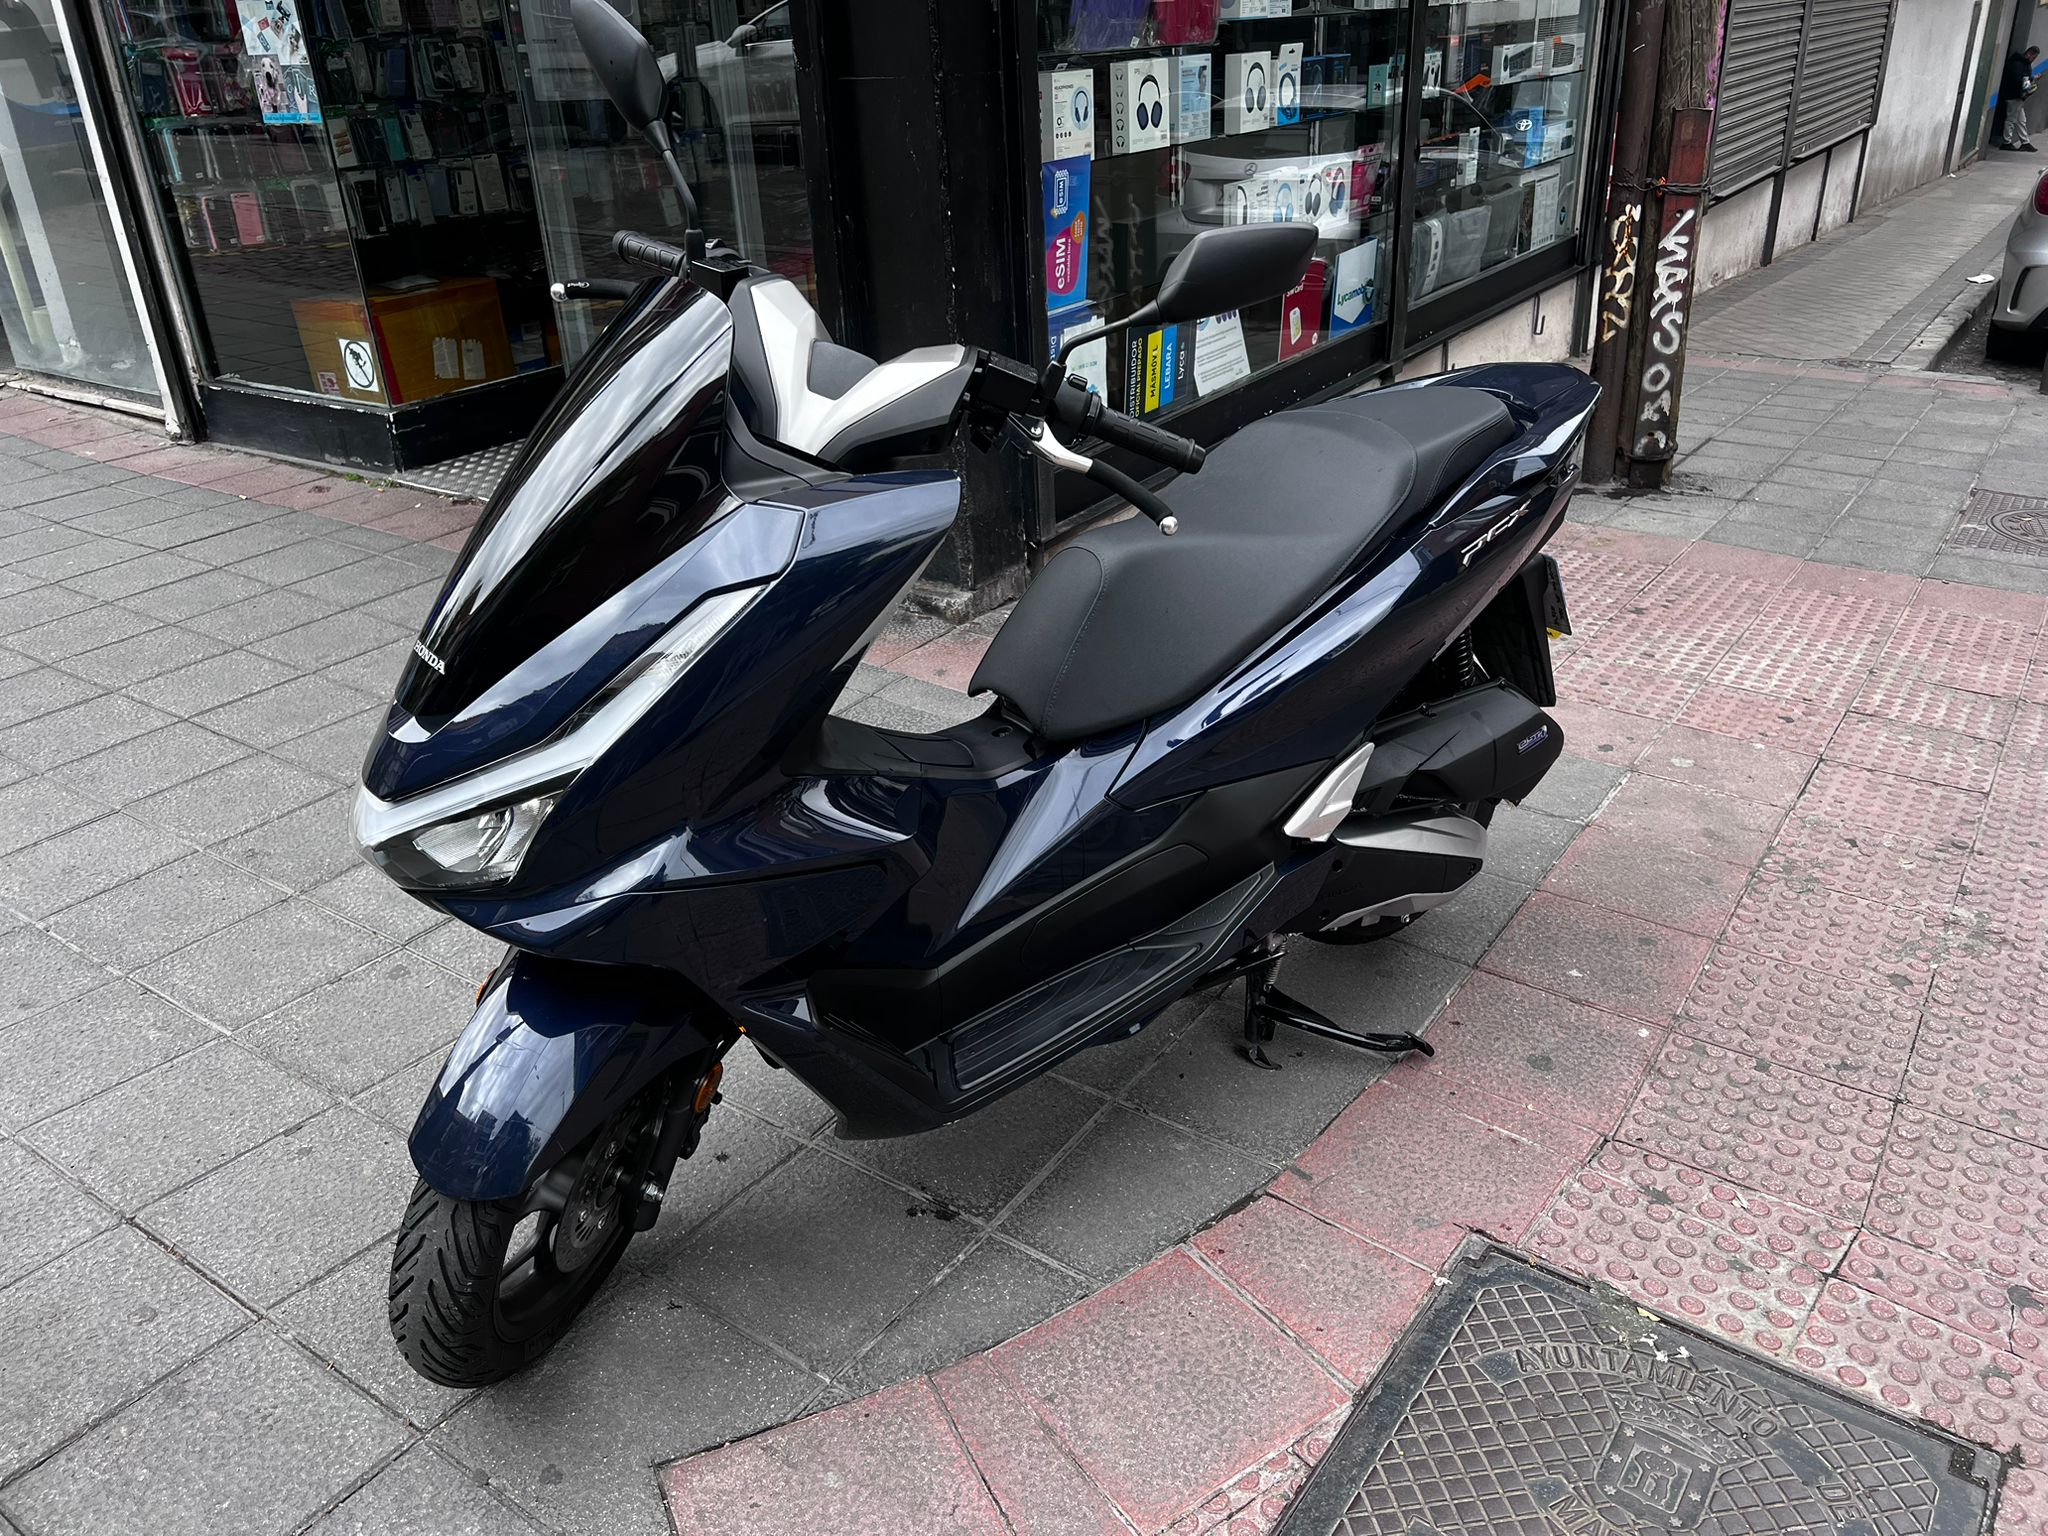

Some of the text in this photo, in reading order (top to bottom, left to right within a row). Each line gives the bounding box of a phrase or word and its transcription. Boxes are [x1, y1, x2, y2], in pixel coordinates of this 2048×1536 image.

[1055, 238, 1066, 290] eSIM
[1129, 340, 1138, 418] DISTRIBUIDOR
[1164, 342, 1173, 389] LEBARA
[1177, 350, 1185, 380] Lyca
[413, 639, 446, 675] HONDA
[1515, 1347, 1866, 1529] AYUNTAMIENTO DE
